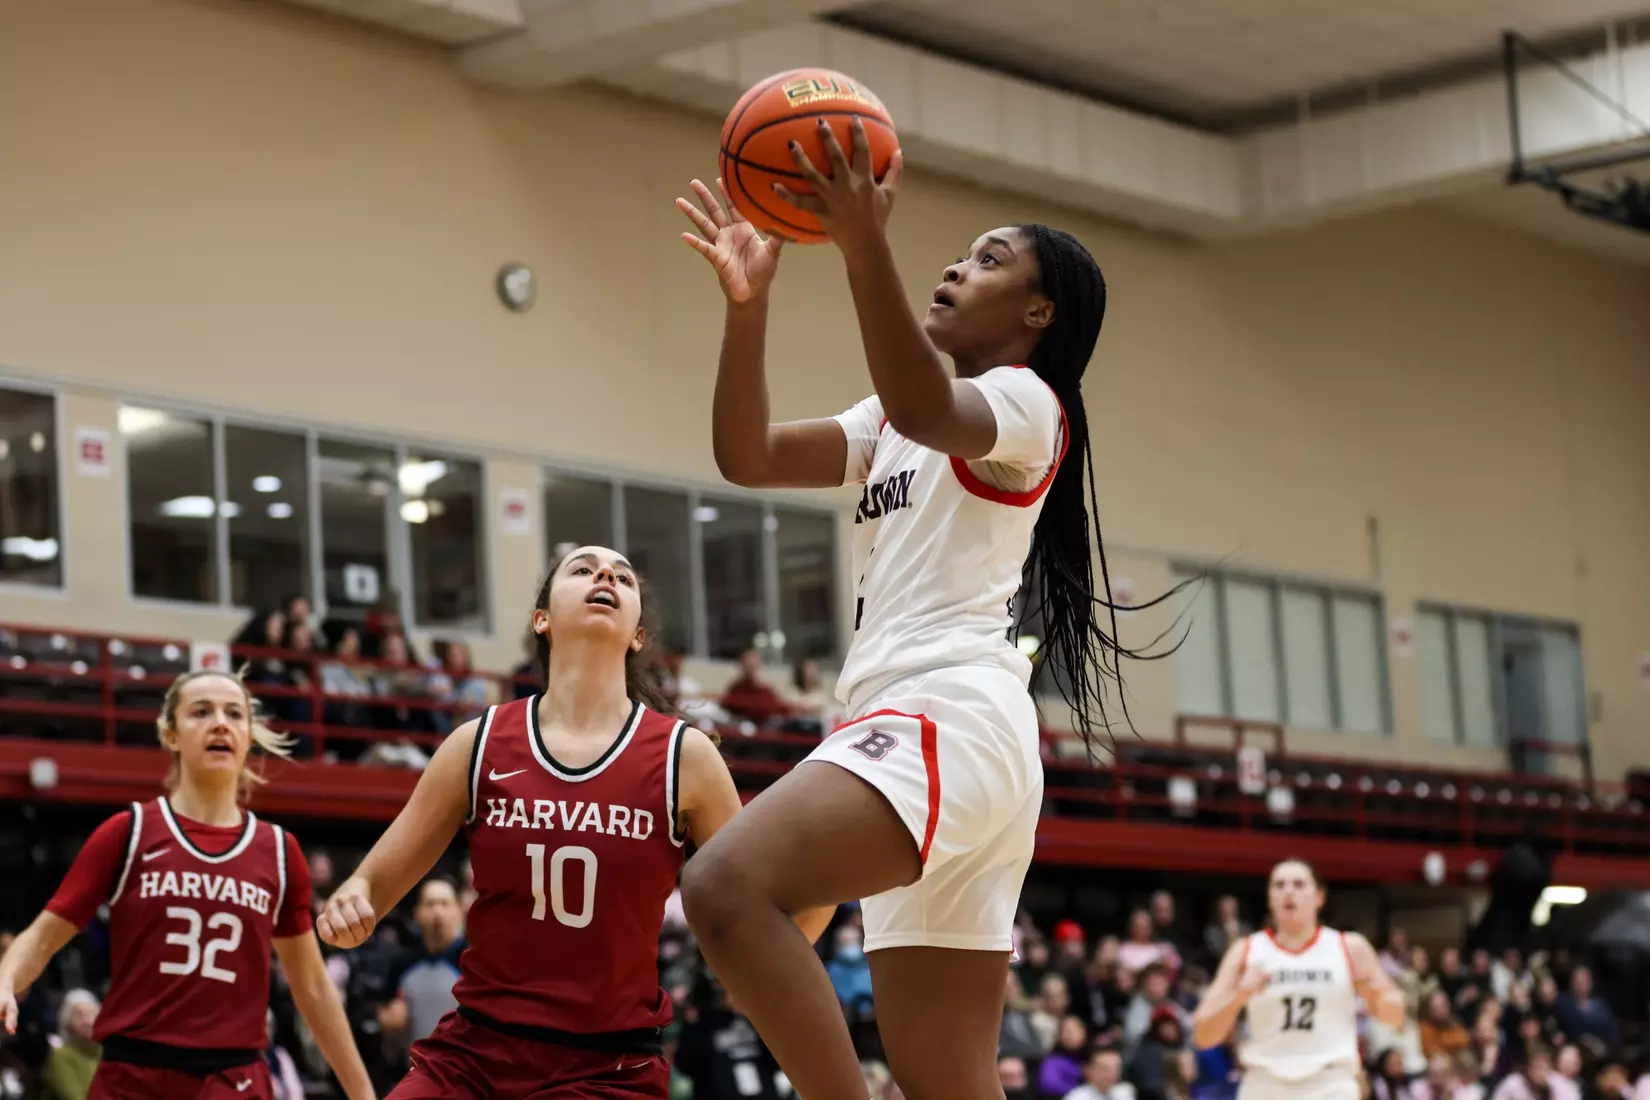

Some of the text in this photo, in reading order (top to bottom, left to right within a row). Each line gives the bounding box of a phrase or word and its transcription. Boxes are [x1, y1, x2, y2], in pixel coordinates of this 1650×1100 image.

[855, 469, 917, 524] ROWN
[848, 729, 899, 761] B
[486, 798, 654, 841] HARVARD
[140, 871, 271, 915] HARVARD
[525, 843, 598, 929] 10
[159, 906, 243, 984] 32
[1281, 996, 1317, 1031] 12
